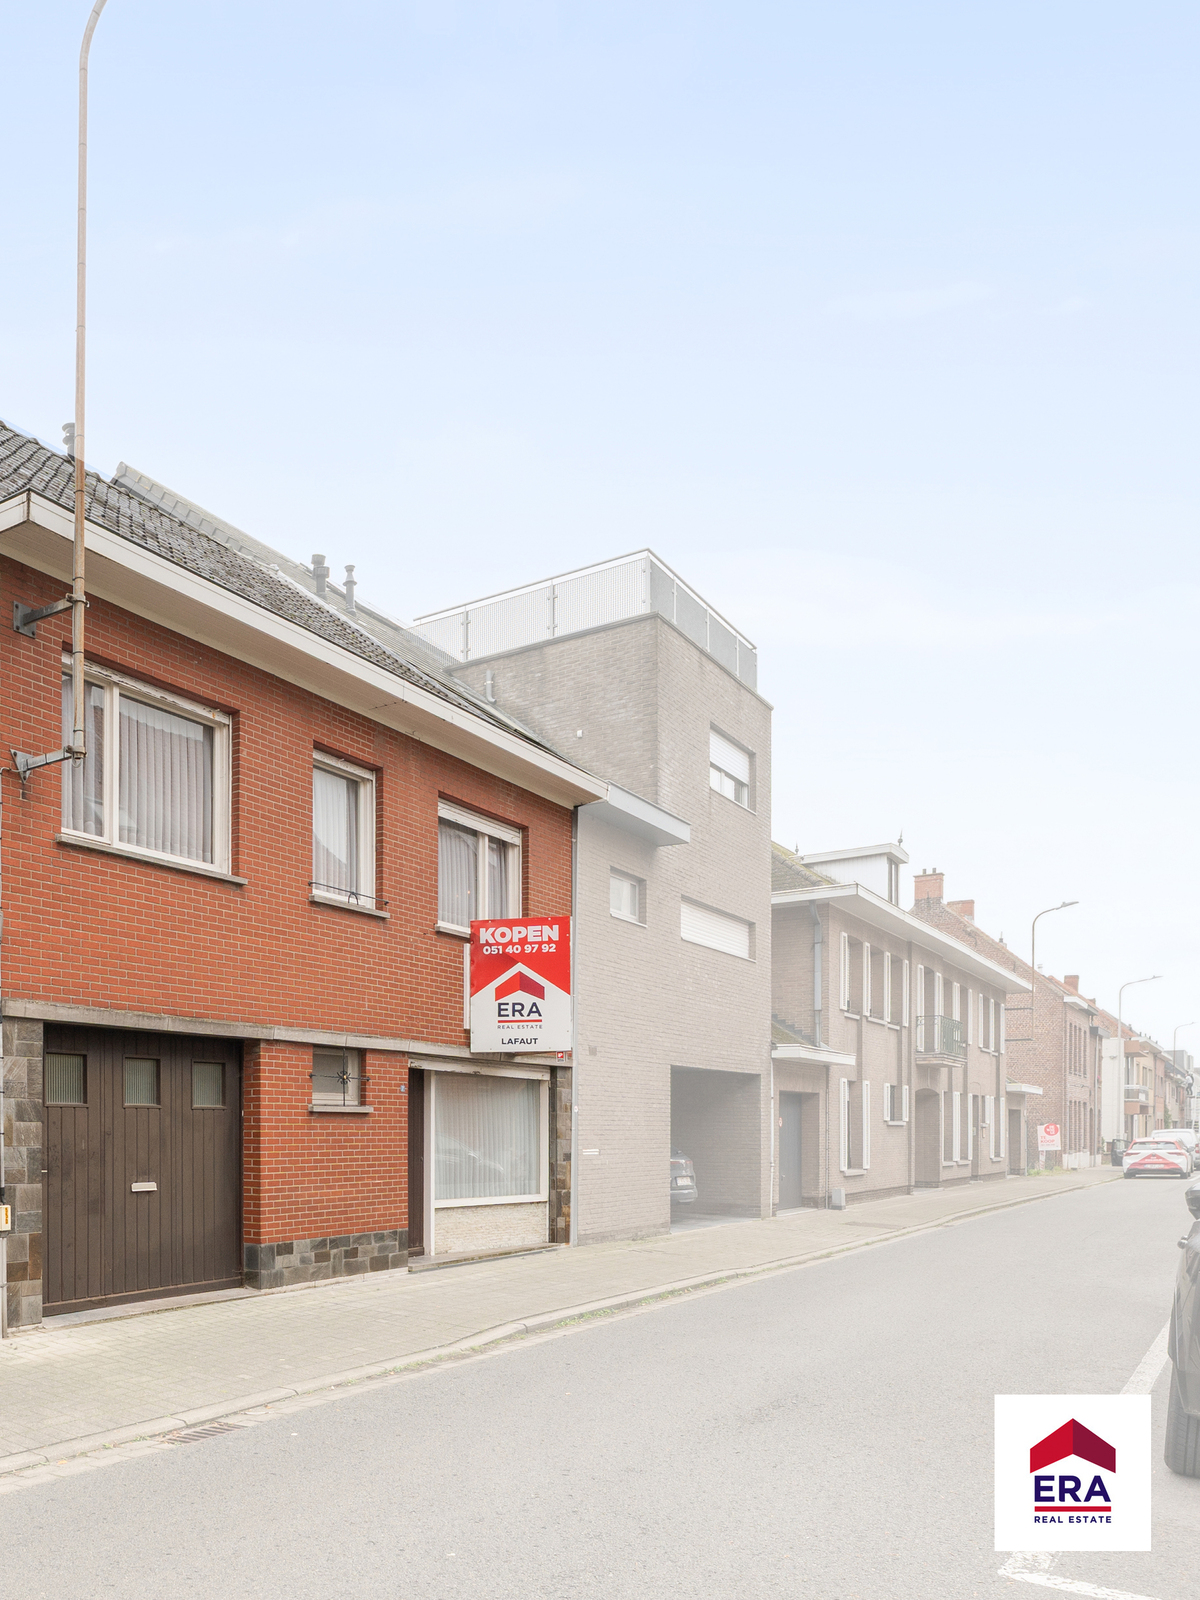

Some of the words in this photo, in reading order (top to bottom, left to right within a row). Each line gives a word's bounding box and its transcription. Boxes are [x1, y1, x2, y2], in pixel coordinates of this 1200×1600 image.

[479, 924, 560, 944] KOPEN
[482, 945, 503, 955] 051
[505, 944, 521, 954] 40
[524, 944, 539, 953] 97
[541, 943, 557, 953] 92
[497, 1001, 543, 1018] ERA
[501, 1037, 539, 1045] LAFAUT
